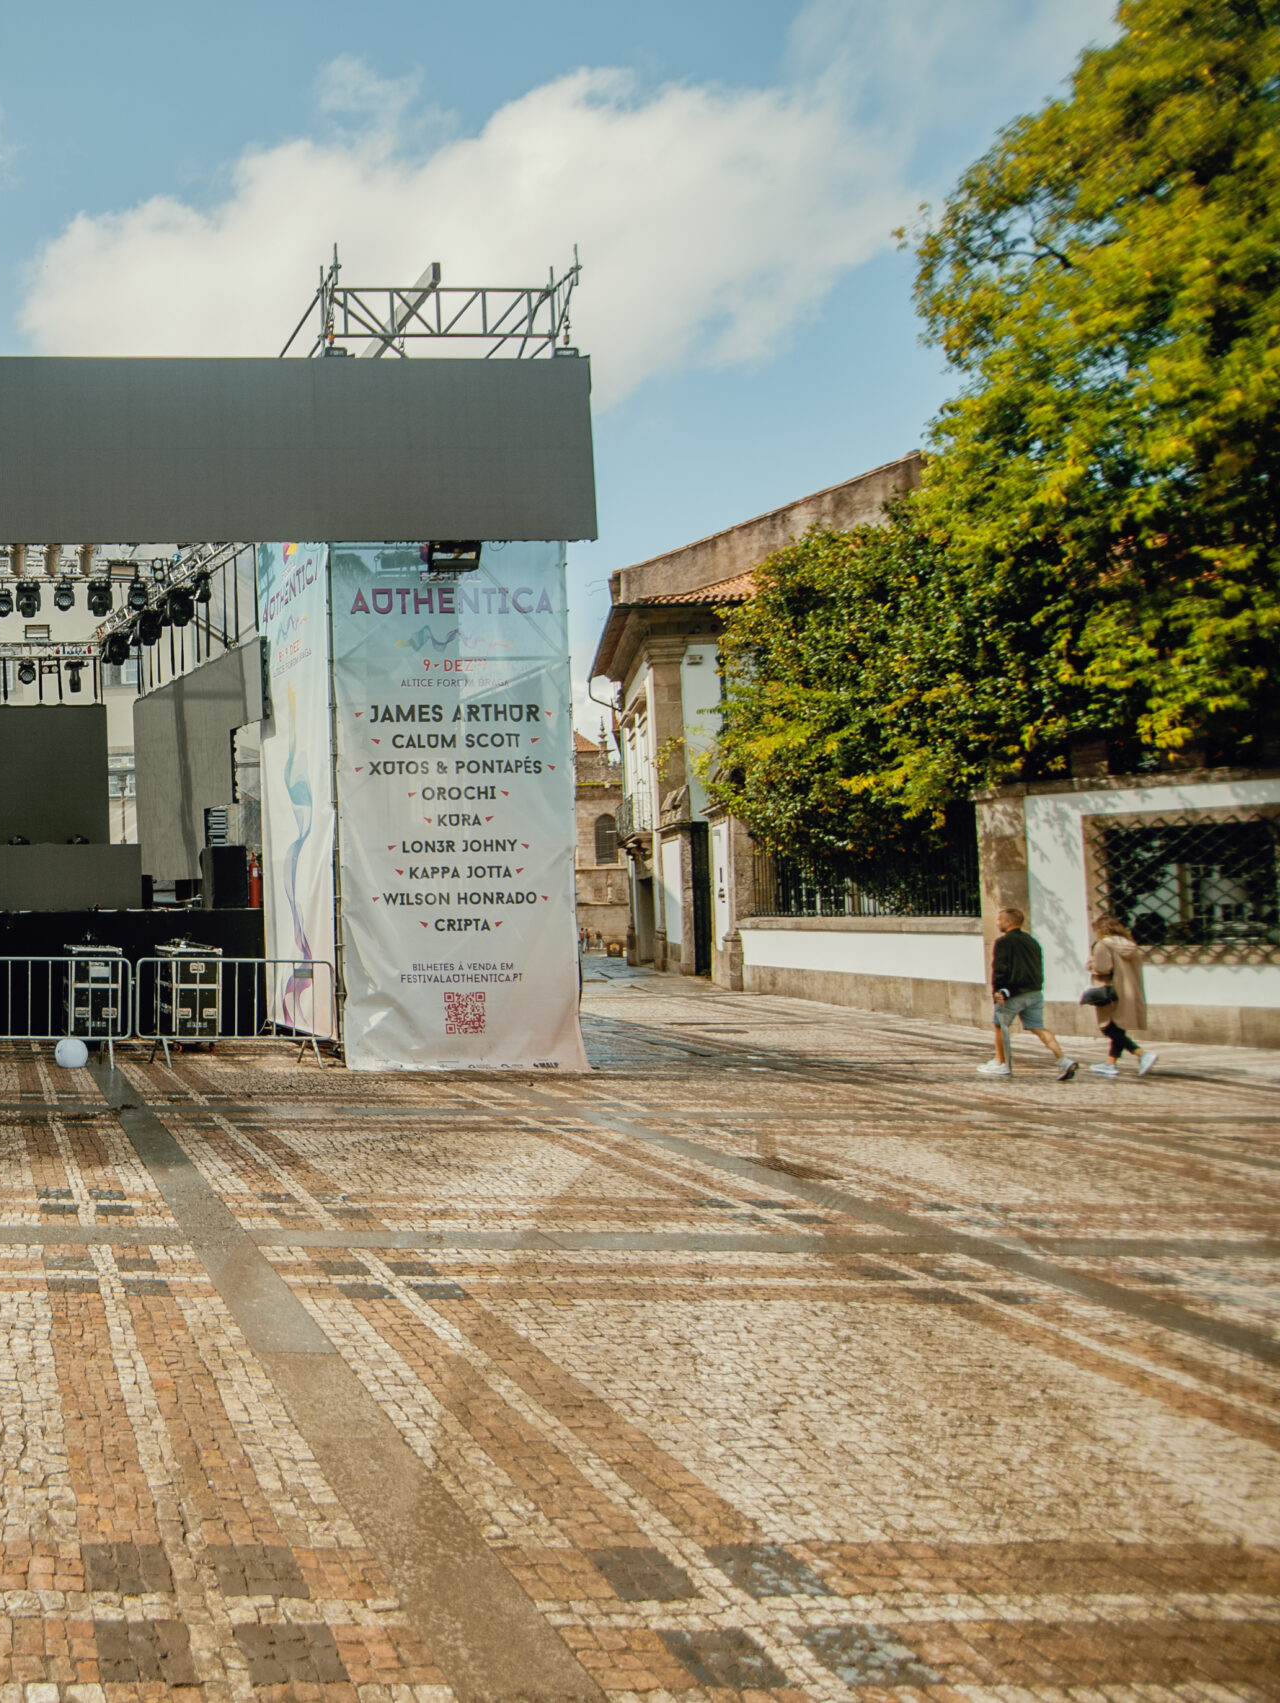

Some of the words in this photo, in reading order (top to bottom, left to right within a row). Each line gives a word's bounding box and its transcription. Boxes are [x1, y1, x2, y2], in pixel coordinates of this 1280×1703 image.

[350, 586, 554, 615] AUTHENTICA
[424, 659, 431, 672] 9
[401, 678, 433, 688] ALTICE
[369, 704, 443, 723] JAMES
[452, 703, 540, 723] ARTHUR
[392, 734, 457, 749] CALUM
[465, 733, 521, 748] SCOTT
[368, 760, 429, 775] XUTOS
[436, 760, 448, 774] &
[455, 755, 543, 774] PONTAPÉS
[421, 785, 497, 801] OROCHI
[437, 813, 482, 826] KURA
[402, 840, 456, 853] LON3R
[462, 839, 517, 852] JOHNY
[409, 866, 461, 879] KAPPA
[466, 866, 513, 879] JOTTA
[382, 893, 450, 906] WILSON
[457, 892, 537, 905] HONRADO
[434, 918, 491, 932] CRIPTA
[412, 963, 455, 972] BILHETES
[467, 963, 498, 971] VENDA
[500, 962, 514, 971] EM
